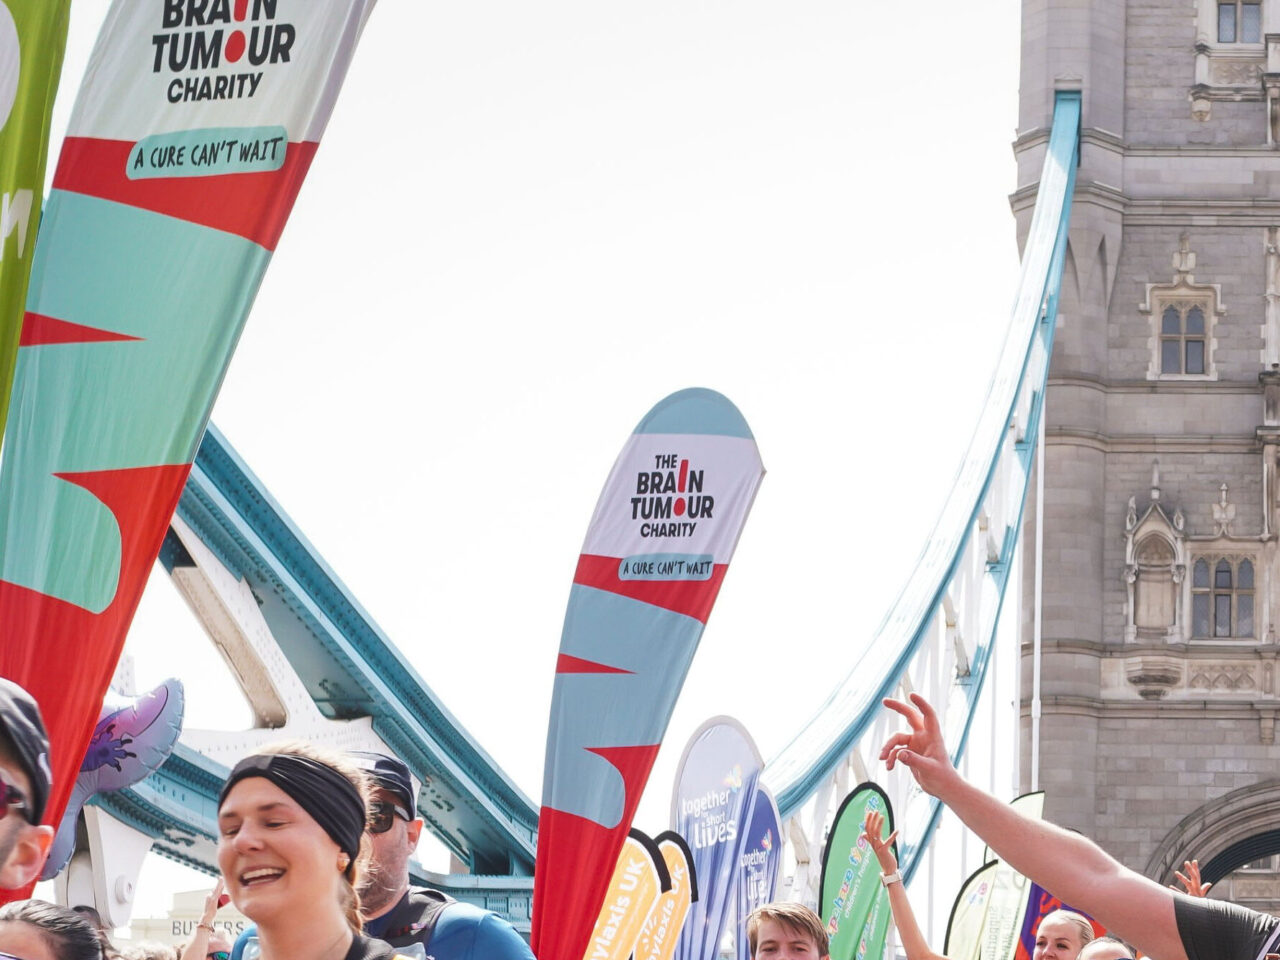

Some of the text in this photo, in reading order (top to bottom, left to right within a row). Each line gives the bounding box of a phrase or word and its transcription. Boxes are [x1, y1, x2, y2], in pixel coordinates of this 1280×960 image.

[152, 23, 296, 73] TUMOUR
[167, 72, 264, 103] CHARITY
[134, 137, 283, 168] A CURE CAN'T WAIT
[655, 454, 678, 469] THE
[636, 459, 704, 494] BRAIN
[631, 495, 714, 520] TUMOUR
[640, 522, 697, 537] CHARITY
[623, 560, 712, 574] A CURE CAN'T WAIT
[682, 789, 731, 818] together
[706, 811, 725, 826] short
[694, 820, 737, 849] lives
[619, 858, 646, 892] UK
